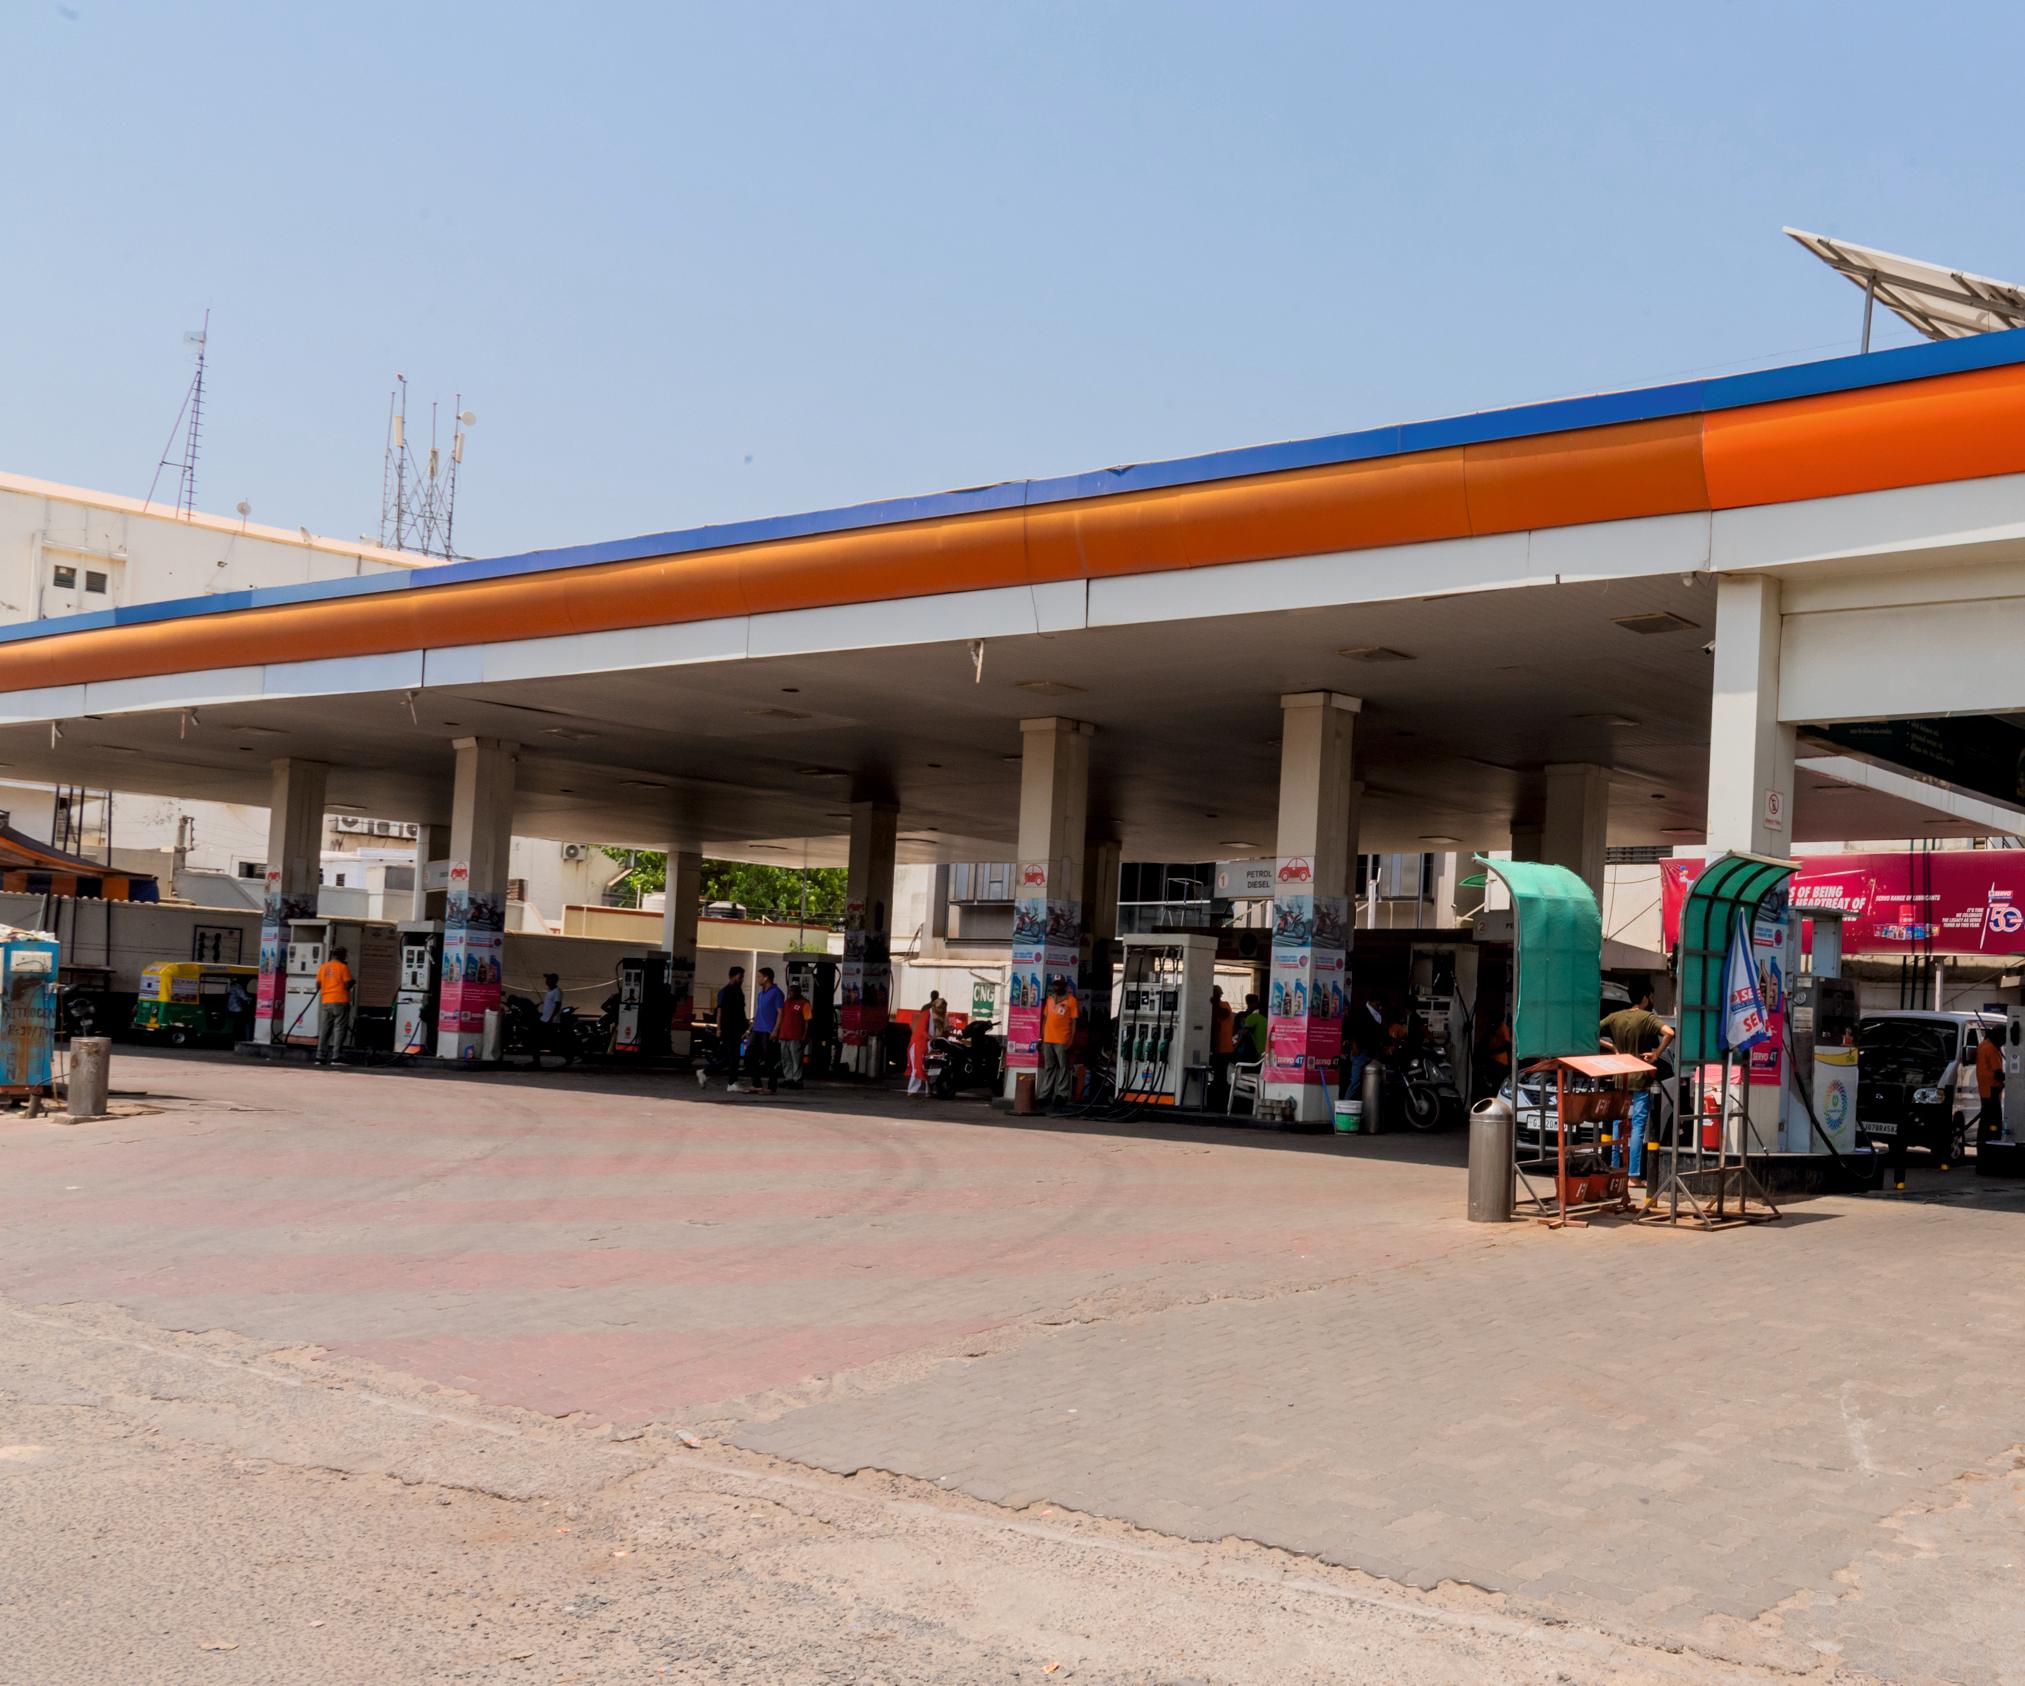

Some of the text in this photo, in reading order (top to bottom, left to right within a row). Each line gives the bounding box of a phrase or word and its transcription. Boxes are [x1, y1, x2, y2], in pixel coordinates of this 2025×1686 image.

[1247, 880, 1270, 888] DIESEL
[1797, 886, 1811, 897] OF
[1812, 885, 1844, 897] BEING
[1851, 897, 1866, 909] OF
[973, 985, 994, 1002] CNG
[1752, 1051, 1777, 1062] SERVO 4T
